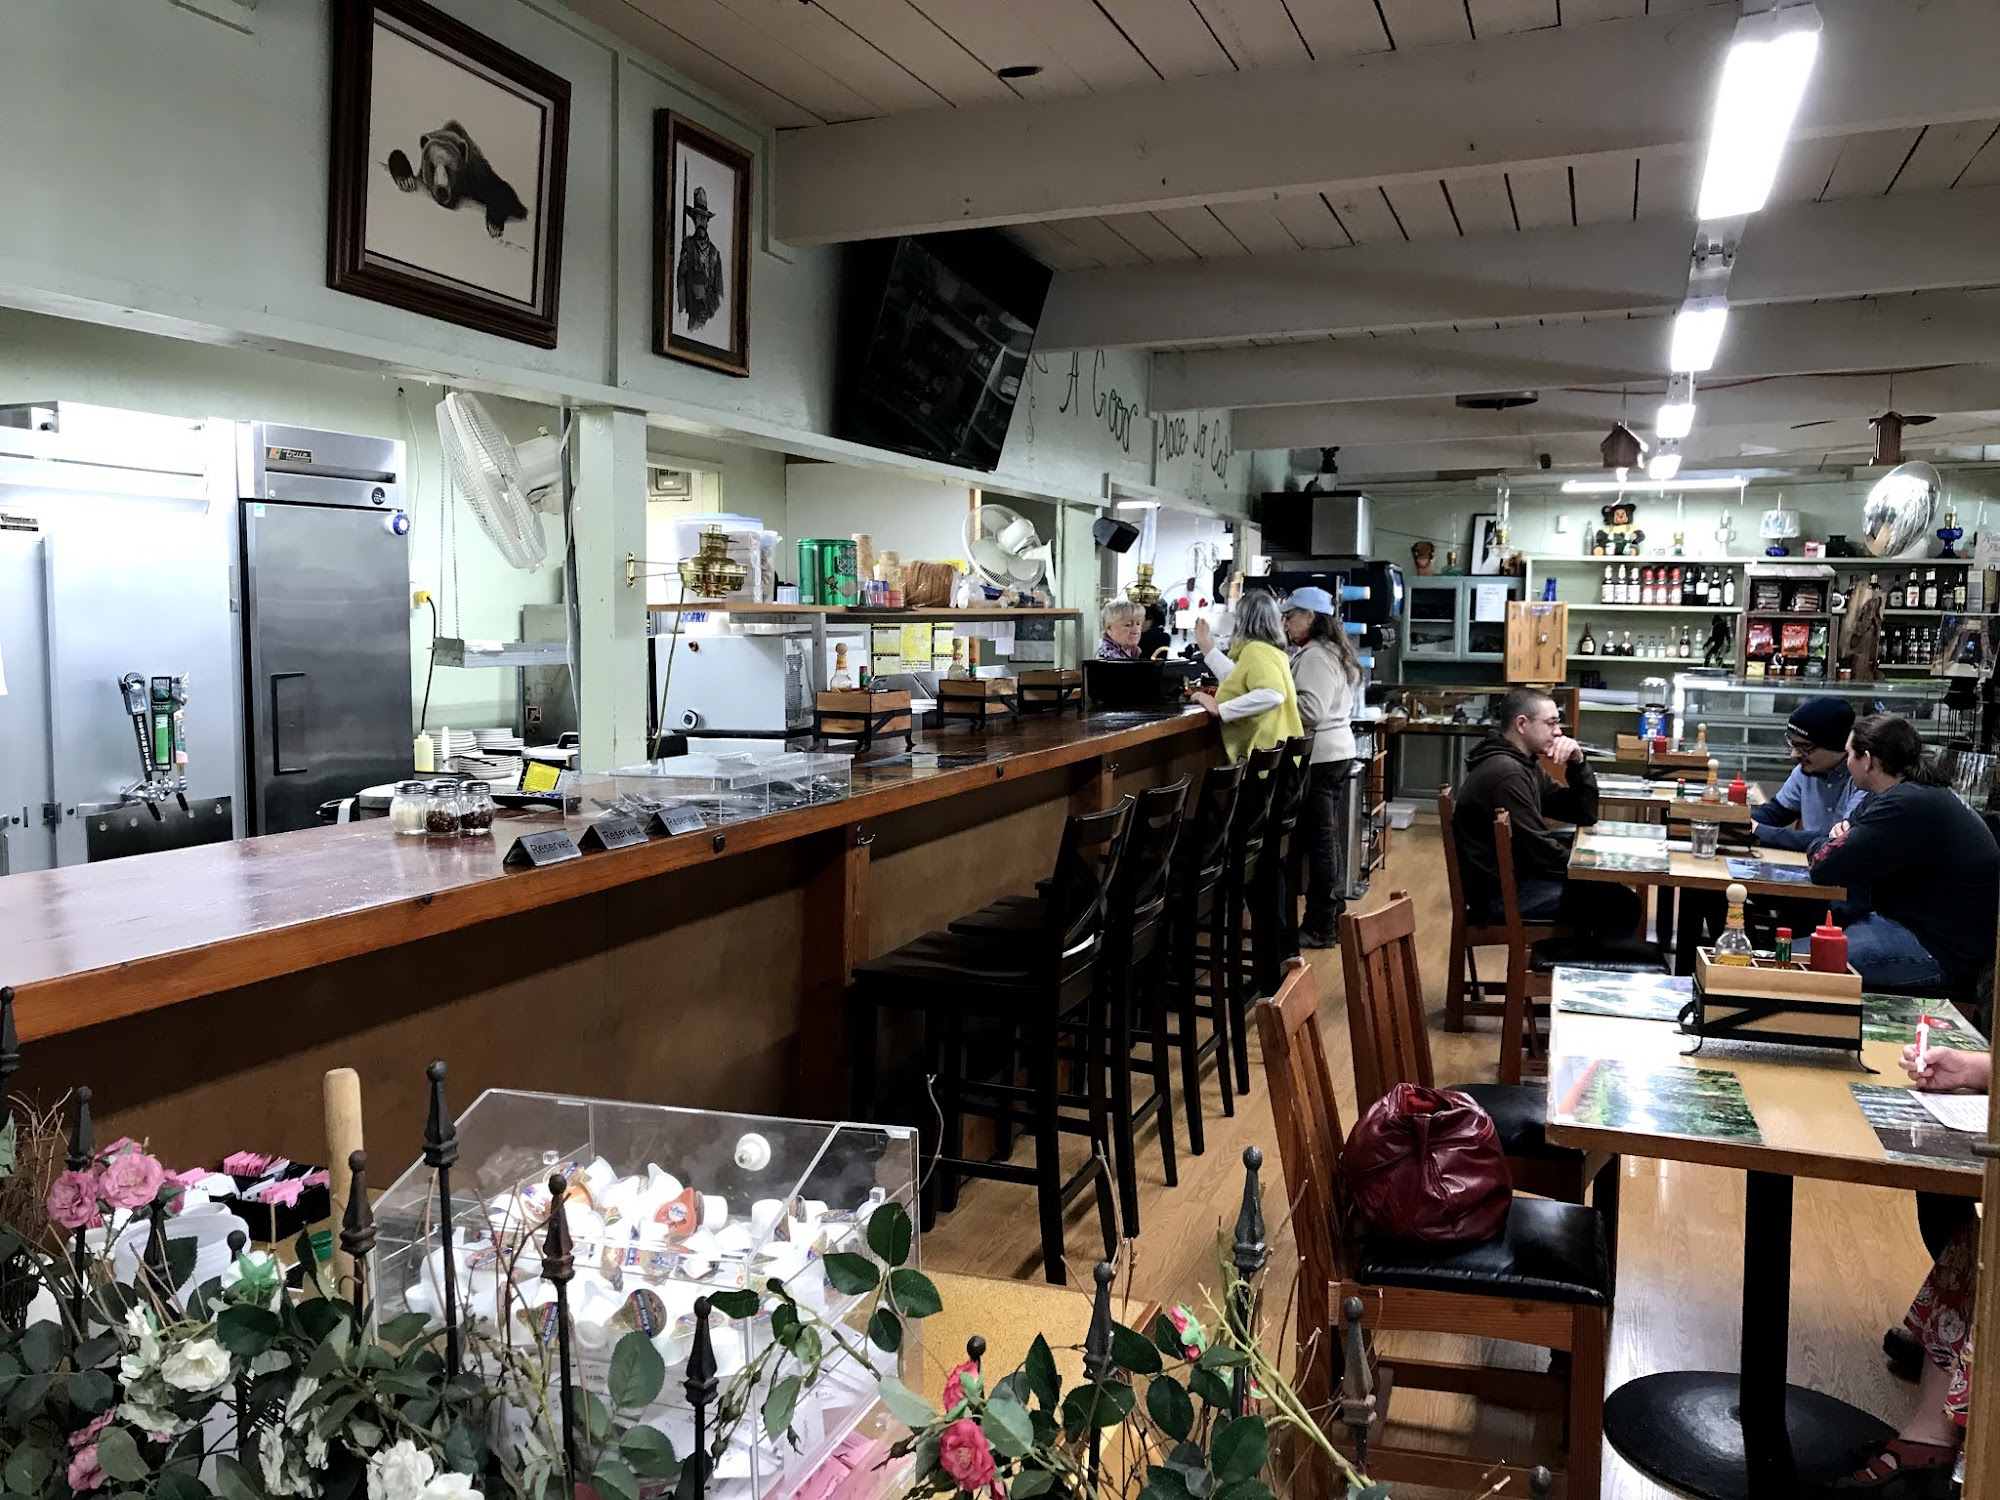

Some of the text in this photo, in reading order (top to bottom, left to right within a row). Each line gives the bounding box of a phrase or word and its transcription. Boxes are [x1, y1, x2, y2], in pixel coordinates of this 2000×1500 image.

[1908, 592, 1919, 605] 7
[136, 715, 153, 772] DESCHUTES
[665, 812, 700, 828] Reserved
[602, 824, 640, 841] Reserved
[530, 837, 574, 855] Reserved
